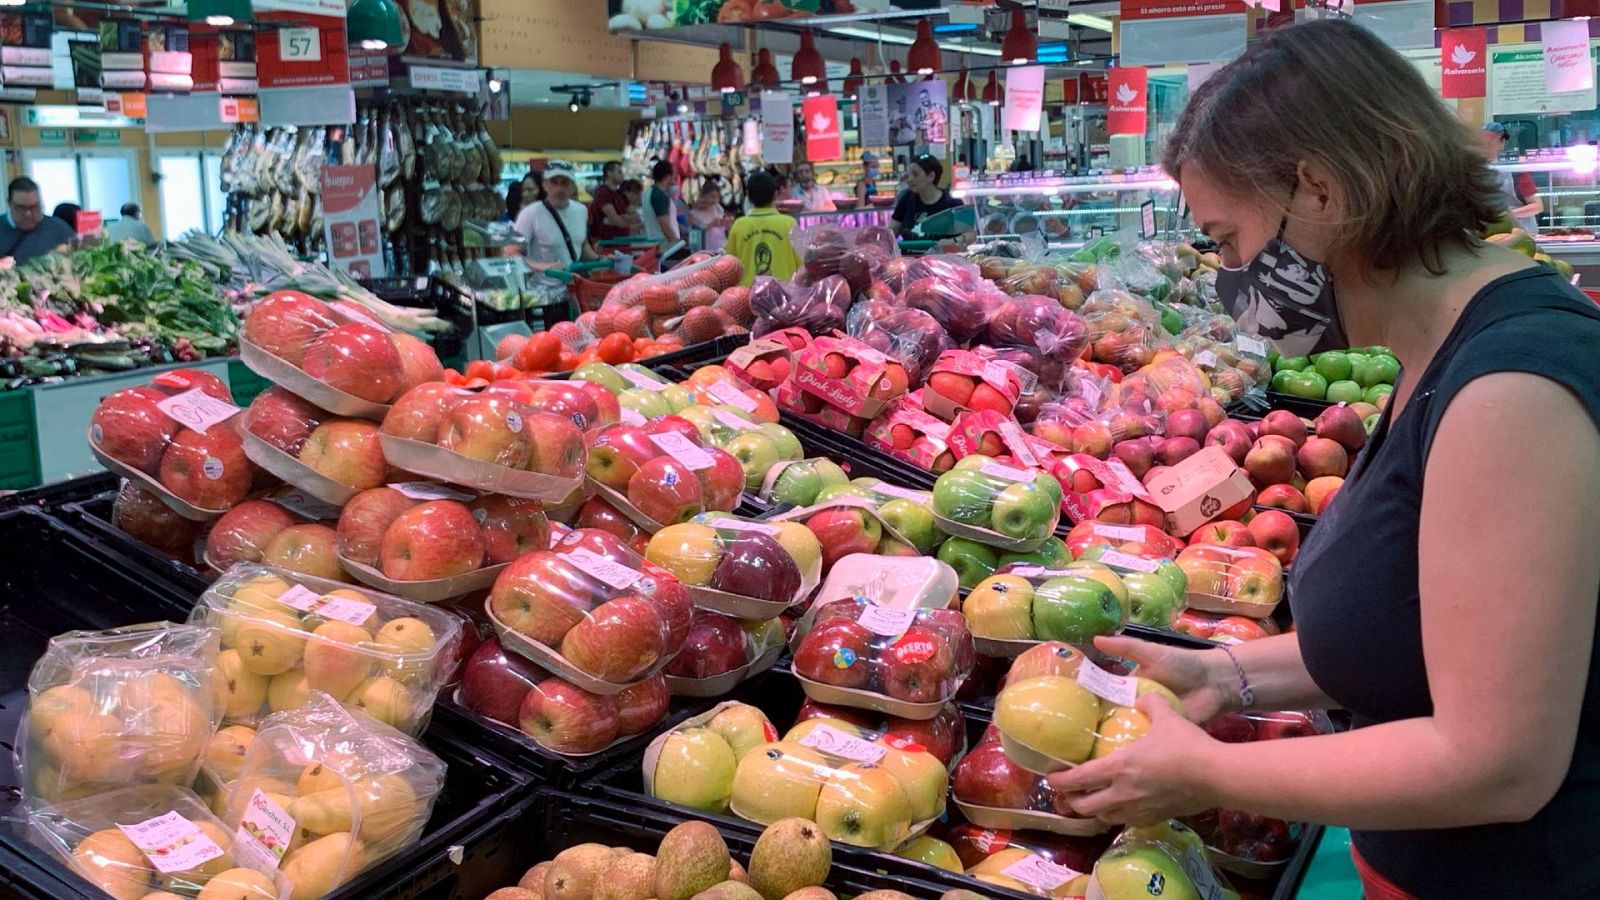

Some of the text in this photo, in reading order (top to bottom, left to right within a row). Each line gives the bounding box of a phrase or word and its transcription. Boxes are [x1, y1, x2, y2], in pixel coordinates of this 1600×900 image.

[1149, 6, 1171, 14] ahorro
[1172, 5, 1186, 13] está
[1204, 3, 1226, 12] precio
[289, 38, 311, 56] 57
[1443, 67, 1486, 75] Aniversario
[728, 95, 740, 105] 60
[799, 371, 857, 408] Pink Lady
[952, 435, 968, 456] Pin
[896, 641, 933, 658] OFERTA
